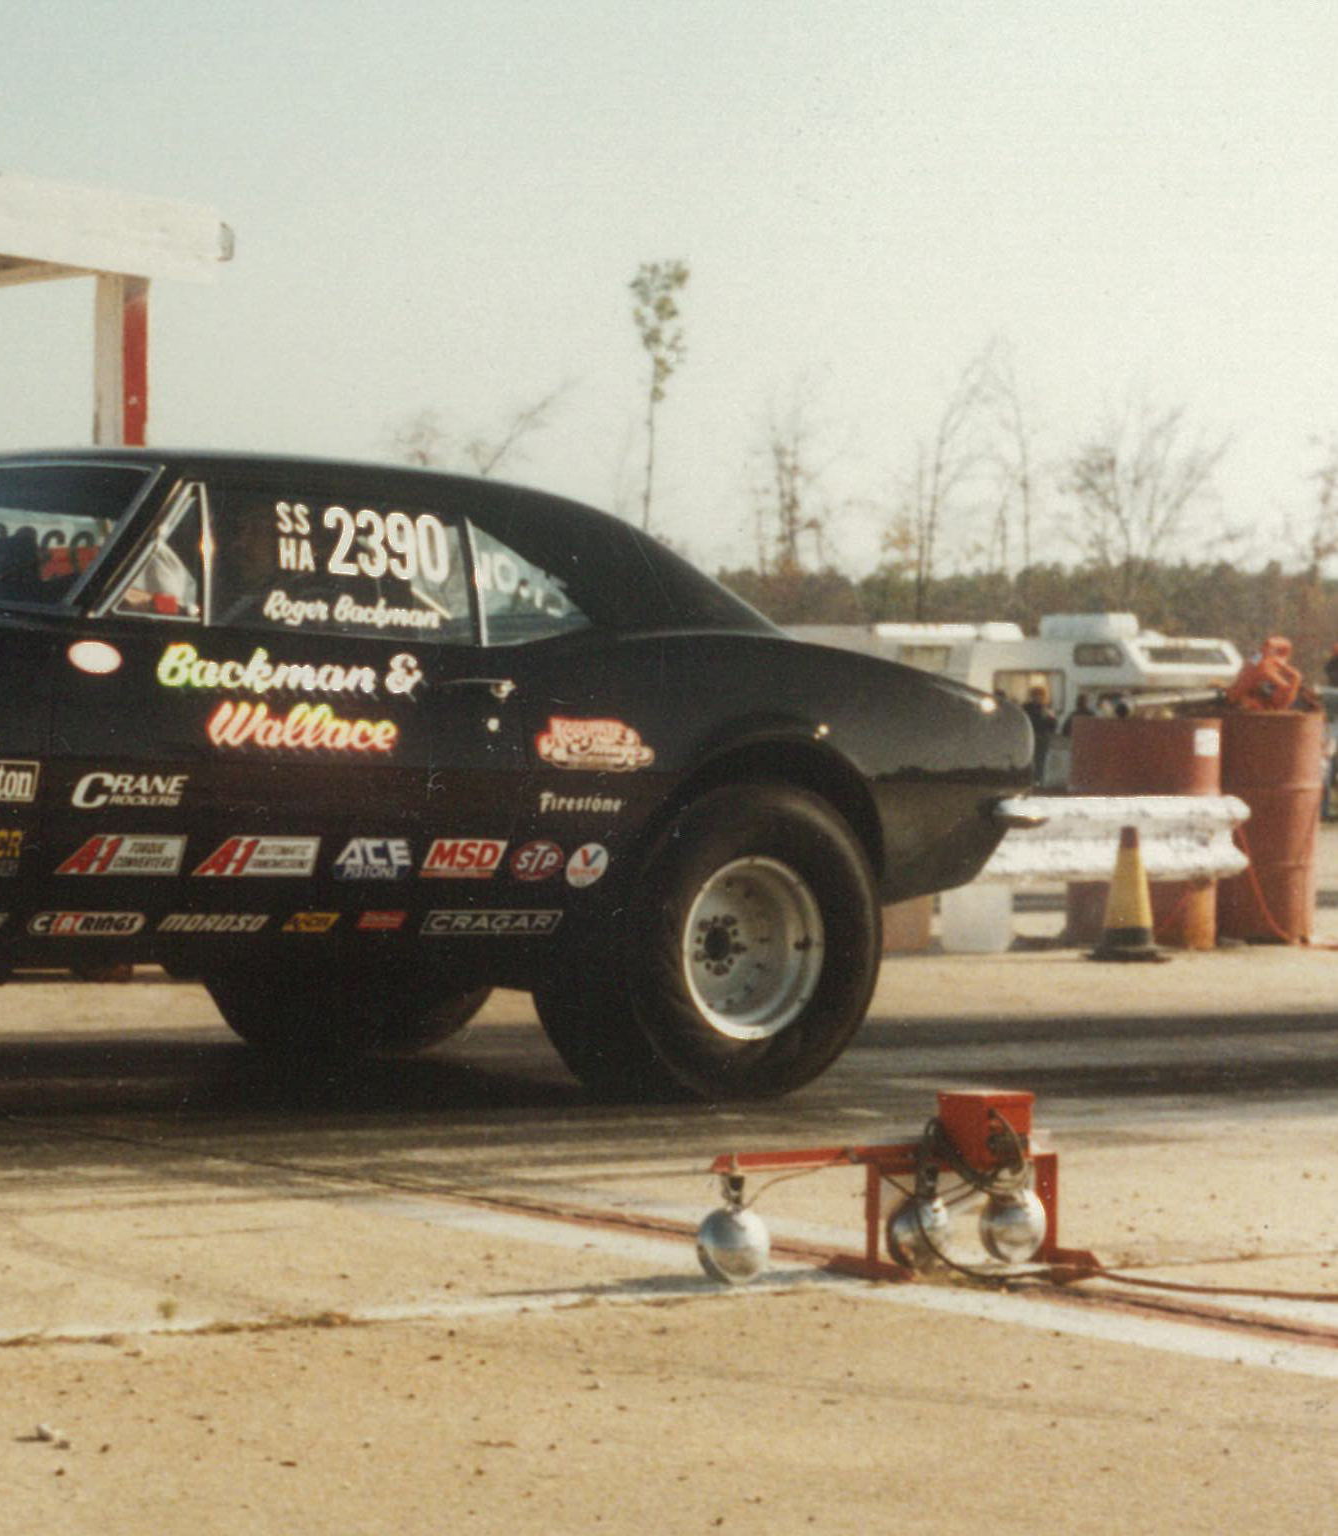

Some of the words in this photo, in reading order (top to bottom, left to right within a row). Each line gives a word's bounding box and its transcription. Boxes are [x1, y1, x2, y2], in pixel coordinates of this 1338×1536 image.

[276, 501, 311, 535] SS
[278, 538, 315, 572] HA
[324, 506, 450, 583] 2390
[263, 590, 329, 626] Roger
[333, 594, 441, 630] Backman
[157, 641, 379, 694] Backman
[385, 653, 423, 694] &
[206, 700, 399, 751] Wallace
[70, 771, 190, 809] CRANE
[540, 790, 626, 814] Firestone
[333, 837, 413, 866] ACE
[426, 840, 502, 870] MSD
[515, 844, 560, 874] STP
[78, 914, 138, 933] RINGS
[157, 913, 271, 932] MOROSO
[429, 914, 553, 931] CRAGAR
